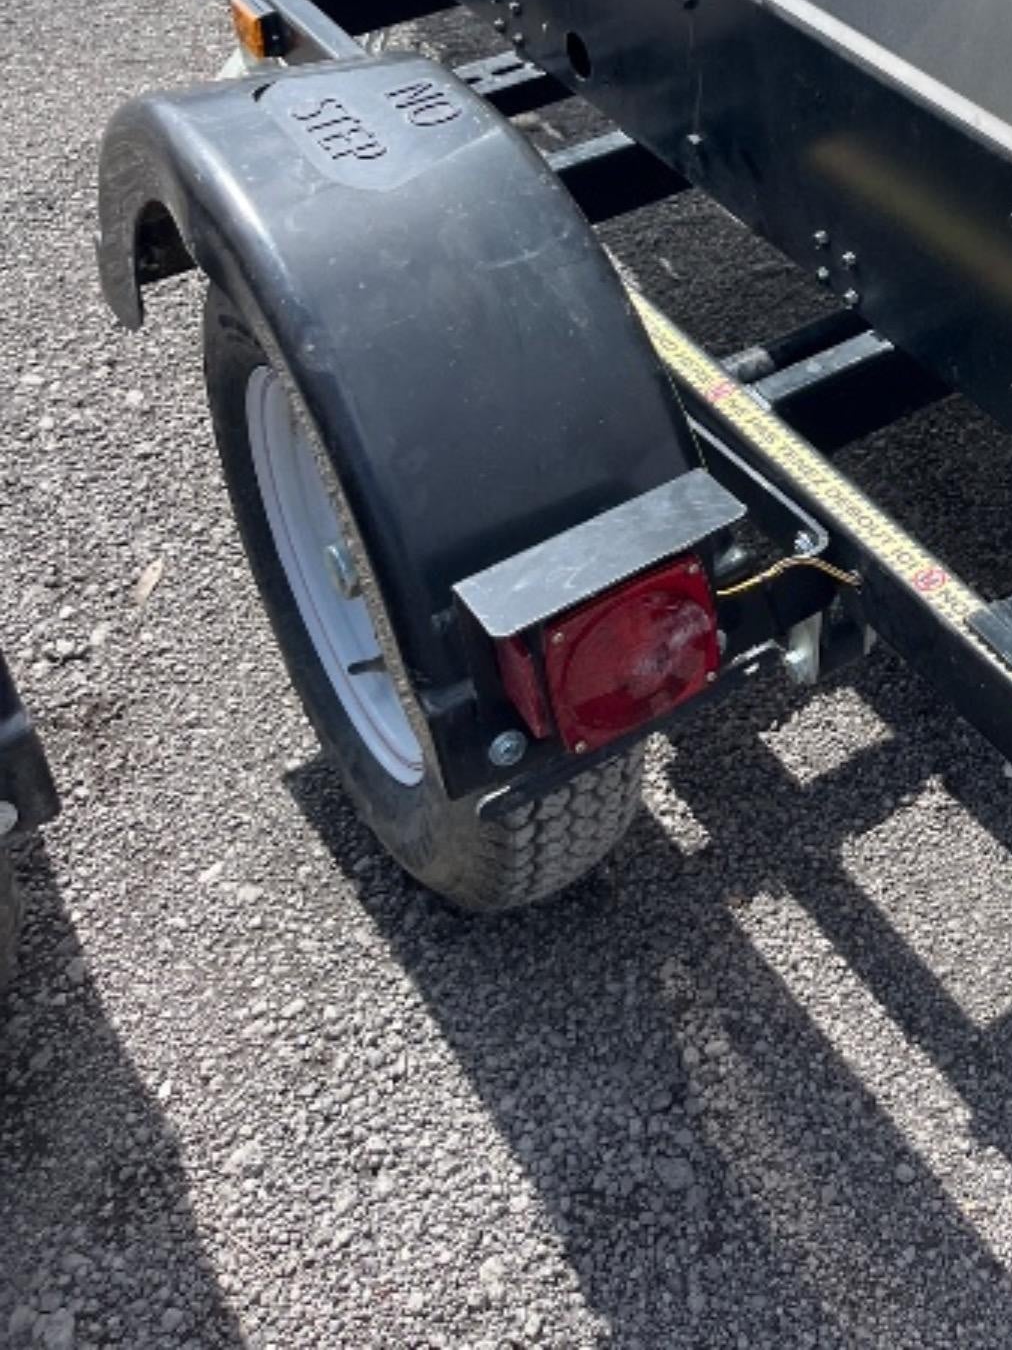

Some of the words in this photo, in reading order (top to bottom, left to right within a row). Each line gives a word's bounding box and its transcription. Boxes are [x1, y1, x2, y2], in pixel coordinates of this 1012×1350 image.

[291, 98, 388, 160] STEP
[385, 82, 463, 127] NO
[823, 481, 898, 554] DEBOUT
